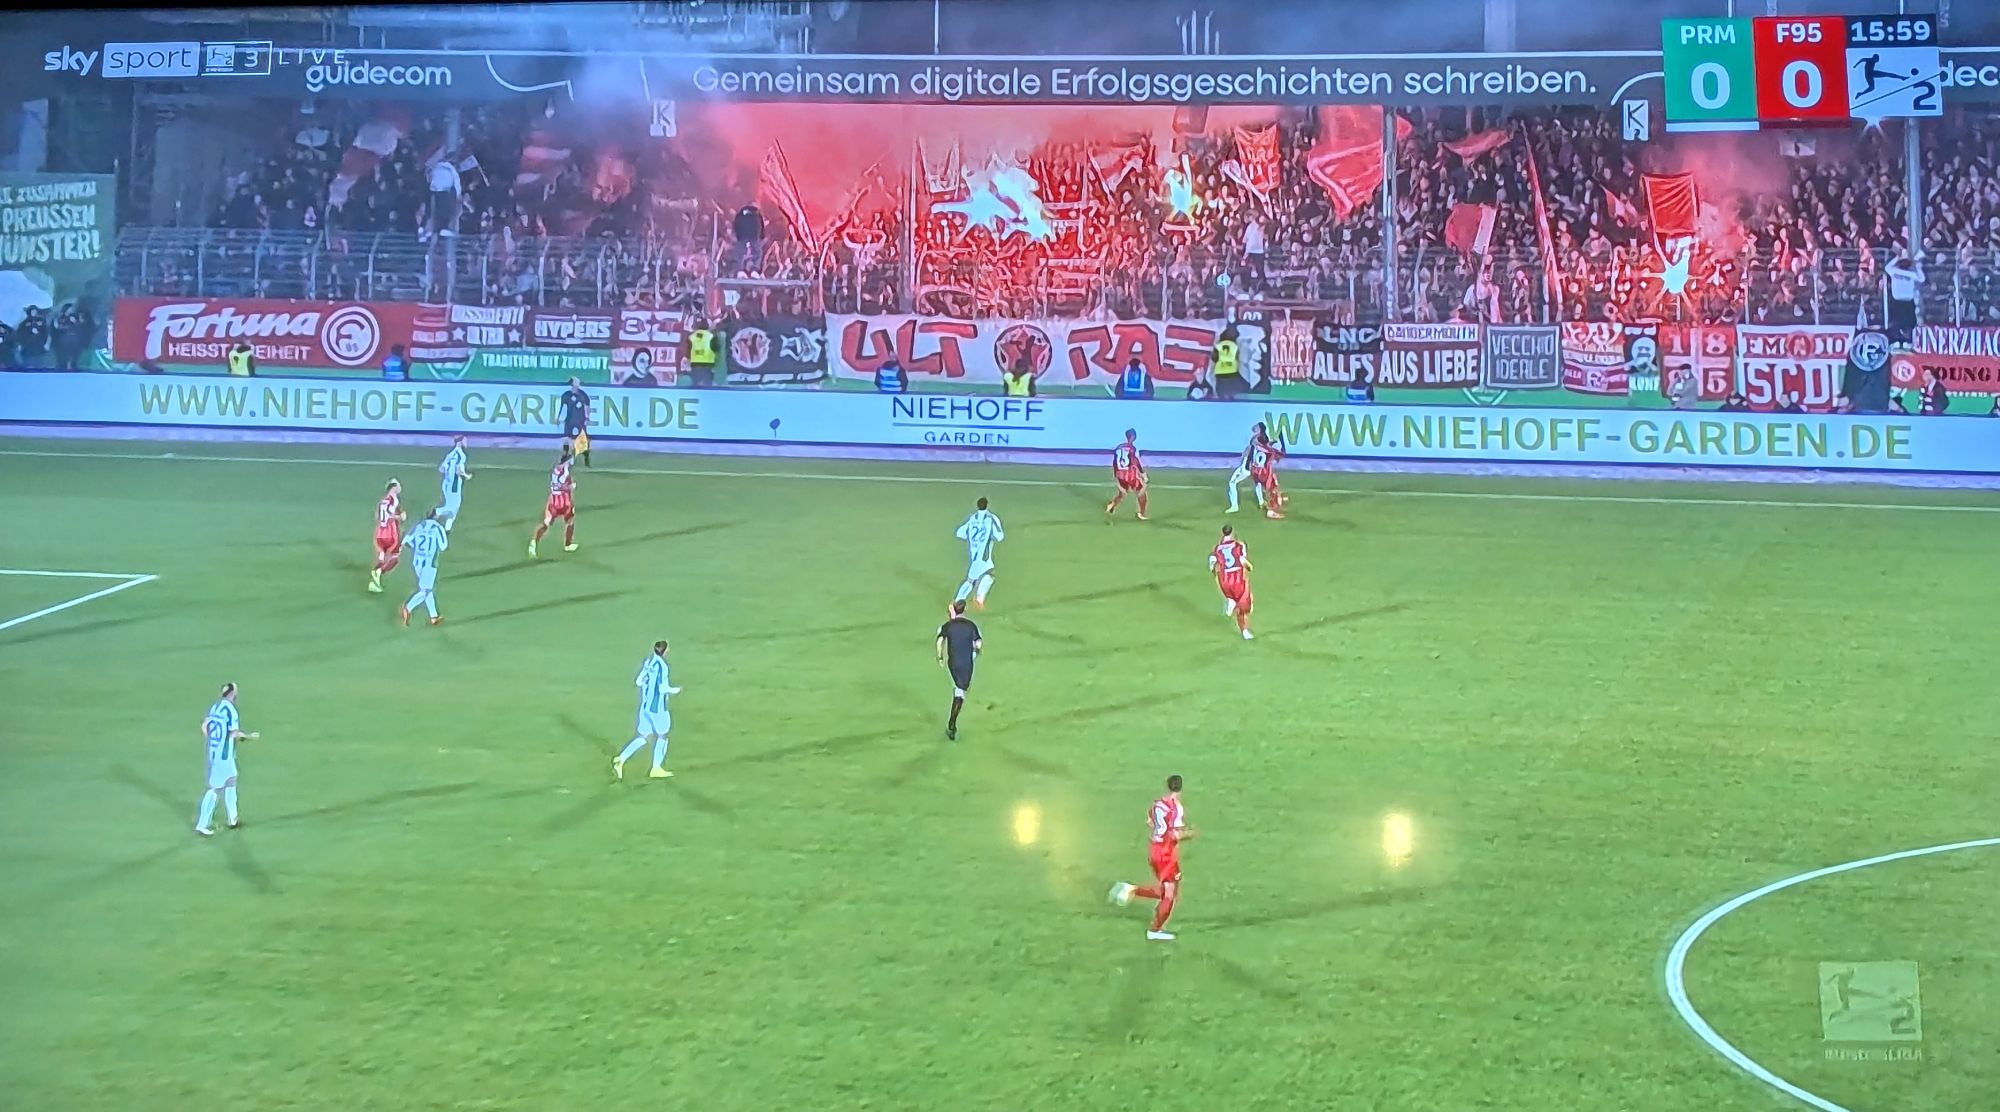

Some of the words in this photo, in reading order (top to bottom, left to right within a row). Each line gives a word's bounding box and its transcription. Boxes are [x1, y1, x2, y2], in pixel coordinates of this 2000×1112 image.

[1680, 25, 1736, 44] PRM
[1776, 23, 1822, 43] F95
[1851, 20, 1930, 42] 15:59
[45, 45, 98, 76] sky
[110, 48, 191, 74] sport
[245, 50, 258, 67] 3
[279, 50, 346, 65] LIVE
[1940, 60, 2000, 87] dec
[306, 60, 451, 92] guidecom
[693, 66, 899, 95] Gemeinsam
[910, 67, 1041, 99] digitale
[1051, 67, 1392, 100] Erfolgsgeschichten
[1404, 64, 1596, 94] schreiben.
[1690, 62, 1731, 109] 0
[1781, 60, 1823, 108] 0
[1912, 80, 1937, 110] 2
[1627, 103, 1644, 128] K
[2, 203, 96, 233] PREUSSEN
[0, 229, 100, 266] ÜNSTER!
[145, 303, 320, 359] Fortuna
[168, 342, 230, 358] HEISST
[235, 344, 311, 361] REIHEIT
[482, 353, 538, 368] TRADITION
[540, 356, 558, 369] MIT
[562, 356, 608, 370] ZUKUNFT
[1313, 351, 1375, 383] ALLES
[1378, 350, 1418, 384] AUS
[1423, 348, 1479, 383] LIEBE
[1495, 358, 1549, 380] IDEALE
[892, 396, 1045, 421] NIEHOFF
[924, 431, 1010, 445] GARDEN
[1265, 411, 1912, 460] WWW.NIEHOFF-GARDEN.DE
